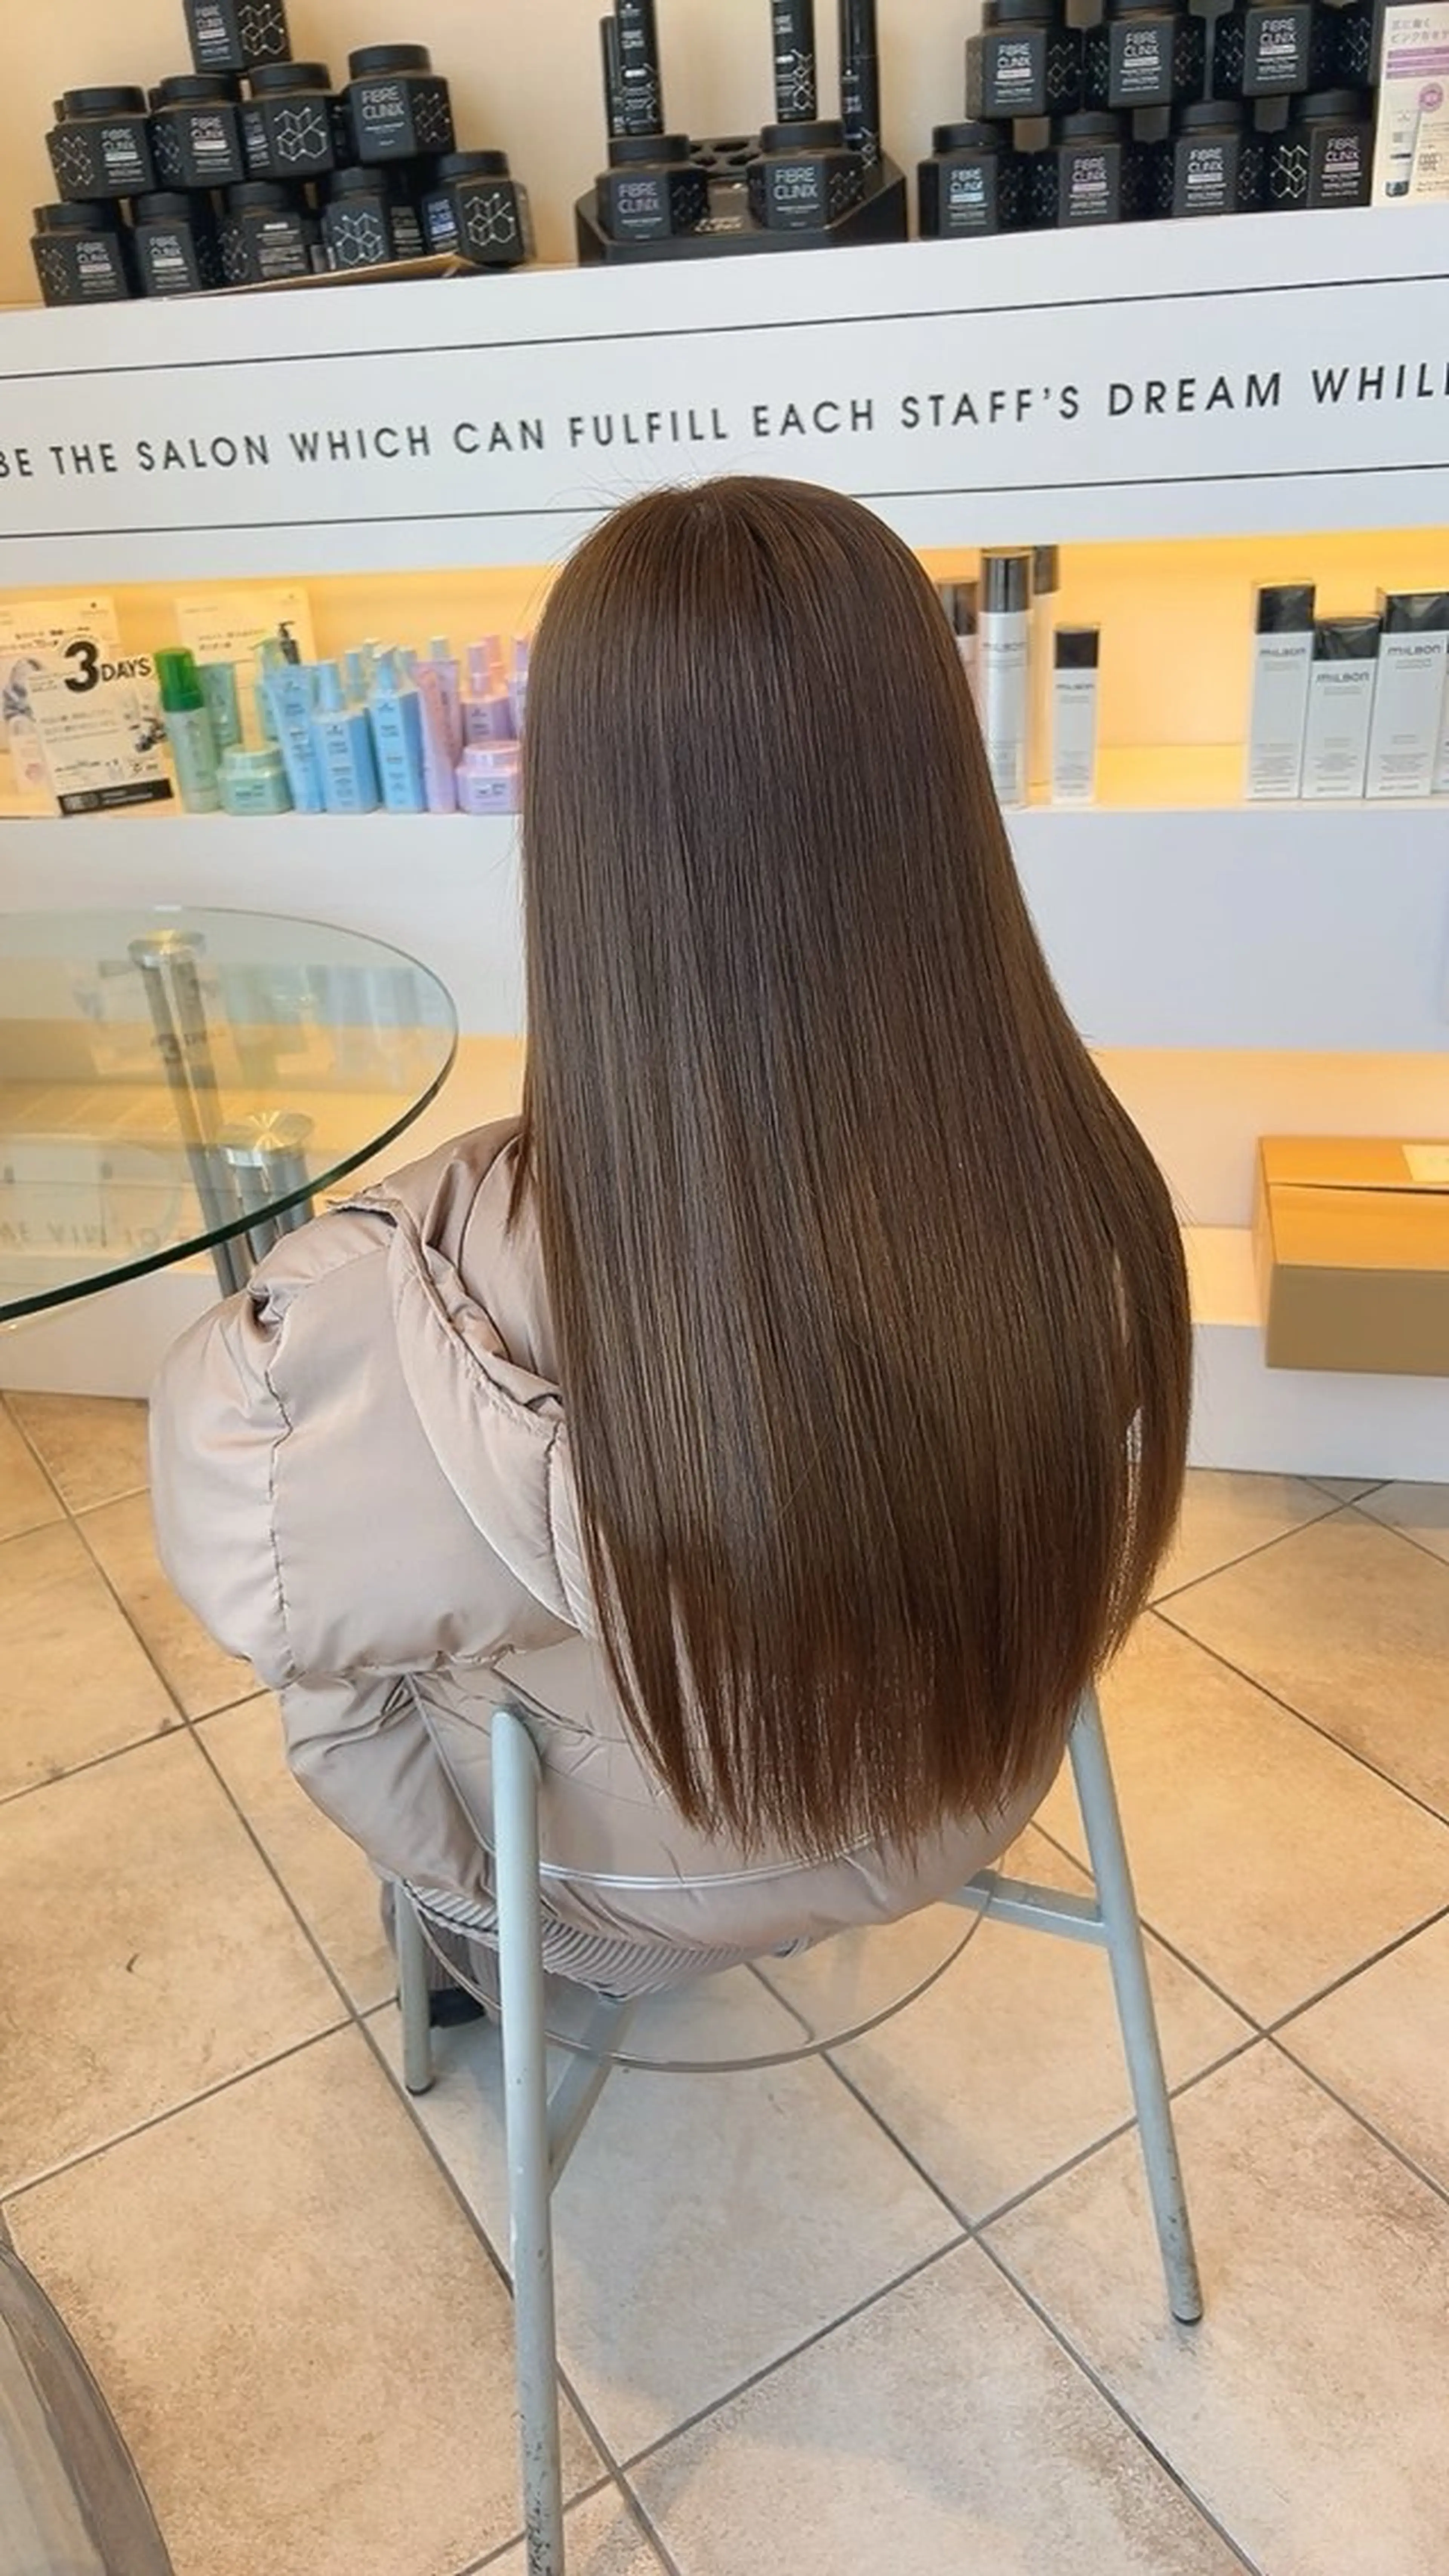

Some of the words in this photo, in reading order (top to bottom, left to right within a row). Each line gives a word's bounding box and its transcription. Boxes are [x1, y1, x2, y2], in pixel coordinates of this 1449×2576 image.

[49, 443, 118, 475] THE
[136, 435, 269, 471] SALON
[289, 425, 430, 462] WHICH
[453, 419, 544, 454] CAN
[569, 408, 728, 448] FULFILL
[753, 399, 873, 437] EACH
[899, 385, 1079, 429] STAFF'S
[1108, 372, 1281, 416] DREAM
[64, 640, 98, 693] 3
[101, 658, 152, 682] DAYS
